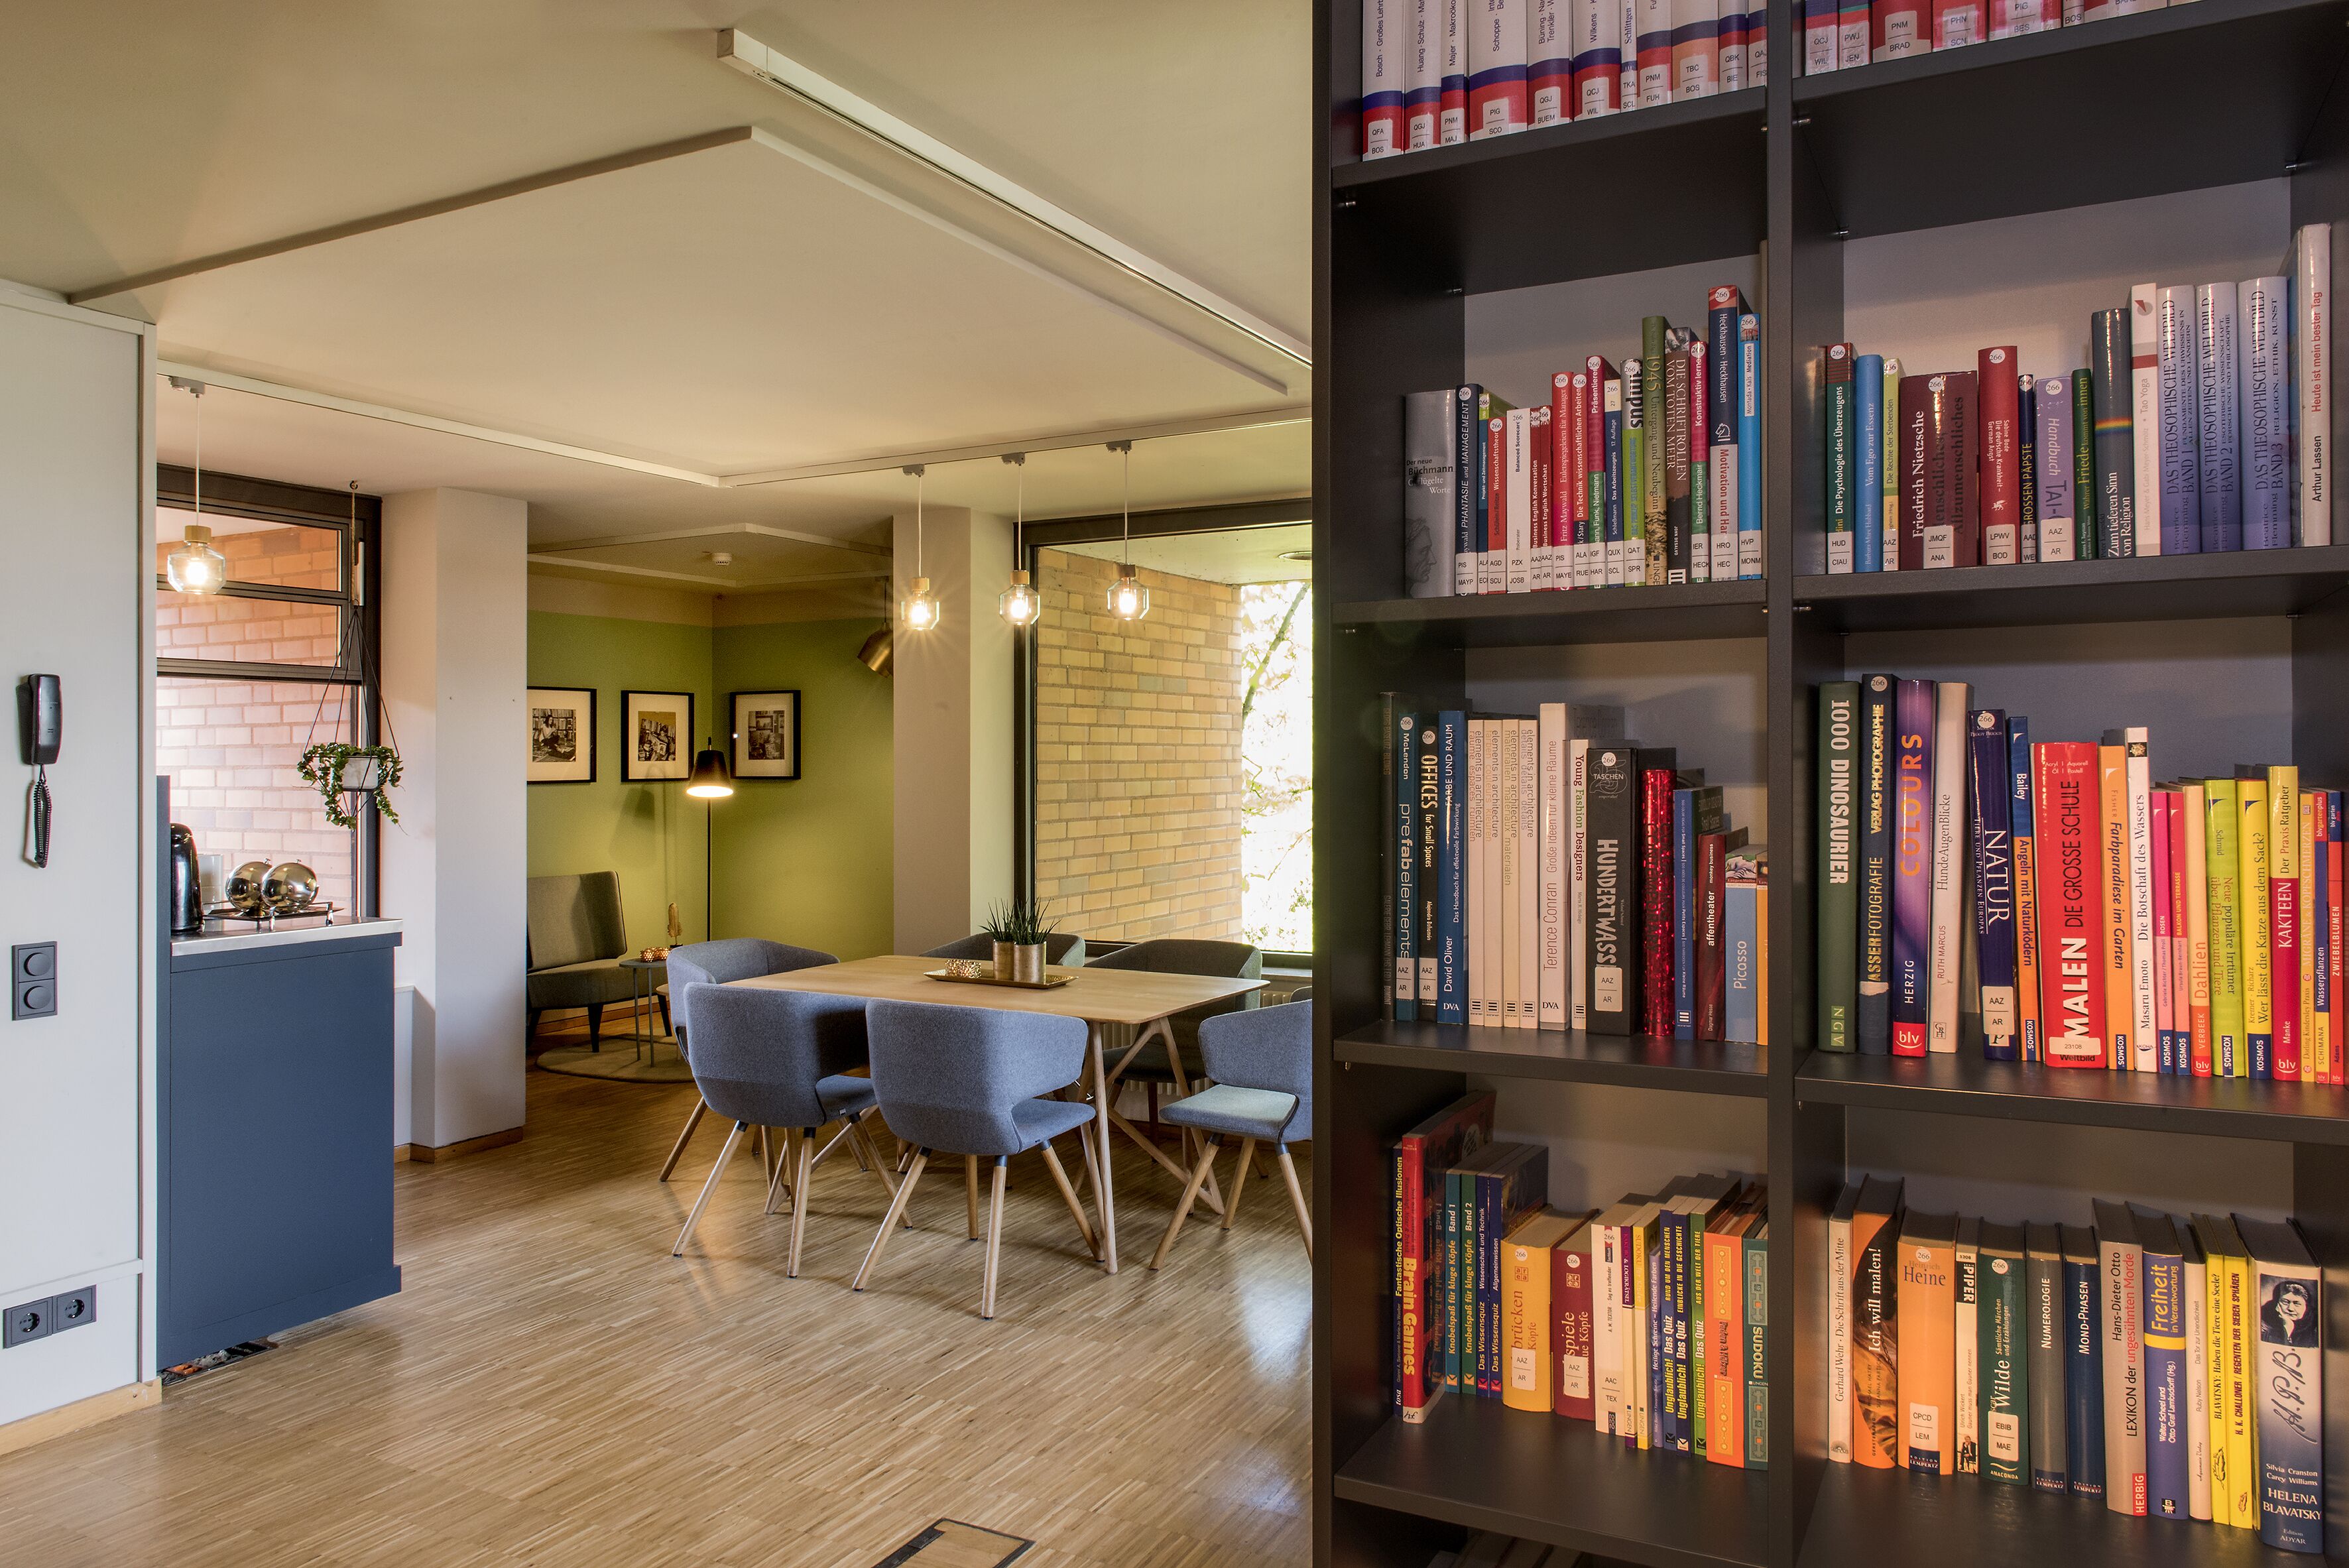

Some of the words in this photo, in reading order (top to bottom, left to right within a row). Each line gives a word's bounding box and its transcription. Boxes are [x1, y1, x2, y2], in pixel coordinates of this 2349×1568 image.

[1891, 21, 1908, 30] PNM
[1417, 48, 1426, 73] Huang
[1890, 40, 1910, 52] BRAD
[1539, 95, 1552, 104] QGJ
[1537, 114, 1555, 125] BUEM
[2311, 291, 2322, 308] Tag
[2311, 311, 2321, 341] bester
[1675, 359, 1686, 380] DIE
[2311, 343, 2321, 366] mein
[1666, 359, 1675, 387] VOM
[2312, 369, 2321, 381] ist
[1559, 389, 1567, 418] Manager
[1666, 390, 1675, 433] TOTEN
[1833, 387, 1844, 437] Überzeugens
[2253, 356, 2268, 462] THEOSOPHISCHE
[2312, 383, 2322, 412] Heute
[1461, 402, 1469, 464] MANAGEMENT
[1675, 383, 1687, 481] SCHRIFTROLLEN
[1865, 402, 1874, 431] Essenz
[1559, 430, 1569, 483] Eulenspiegeleien
[1666, 436, 1675, 470] MEER
[1834, 438, 1842, 452] des
[1866, 448, 1876, 465] Ego
[1911, 411, 1925, 475] Nietzsche
[2047, 418, 2061, 475] Handbuch
[2312, 436, 2322, 470] Lassen
[1834, 454, 1845, 499] Psychologie
[1866, 467, 1874, 487] Vom
[2077, 447, 2090, 483] Friede
[2255, 464, 2268, 490] DAS
[2271, 455, 2284, 489] BAND
[1695, 464, 1704, 500] Heckmair
[2106, 472, 2117, 494] Sinn
[2312, 471, 2322, 503] Arthur
[1559, 491, 1569, 523] Maywald
[1695, 501, 1704, 524] Bernd
[1911, 478, 1925, 538] Friedrich
[2107, 495, 2118, 531] tieferen
[2120, 497, 2132, 536] Religion
[1990, 532, 2010, 540] LPWV
[2108, 532, 2119, 557] Zum
[1831, 699, 1849, 751] 1000
[1420, 756, 1437, 809] OFFICES
[1574, 756, 1585, 787] Young
[1573, 790, 1583, 828] Fashion
[1830, 760, 1848, 884] DINOSAURIER
[1900, 735, 1922, 876] COLOURS
[2060, 781, 2080, 837] SCHULE
[2134, 793, 2145, 838] Wassers
[1573, 832, 1585, 882] Designers
[1937, 795, 1952, 891] HundeAugenBlicke
[2136, 842, 2145, 861] des
[2253, 833, 2266, 864] Sack?
[1984, 831, 2010, 926] NATUR
[2062, 841, 2082, 902] GROSSE
[2108, 823, 2124, 902] Farbparadiese
[2136, 864, 2147, 918] Botschaft
[2255, 868, 2265, 893] dem
[1543, 883, 1557, 924] Conran
[1706, 890, 1715, 947] affentheater
[2064, 906, 2084, 928] DIE
[2111, 908, 2123, 923] im
[2258, 896, 2266, 915] aus
[2277, 882, 2293, 949] KAKTEEN
[2137, 921, 2148, 941] Die
[2256, 918, 2267, 950] Katze
[2331, 907, 2340, 977] ZWIEBELBLUMEN
[1443, 936, 1453, 965] Oliver
[1543, 927, 1558, 972] Terence
[2112, 928, 2125, 969] Garten
[2258, 953, 2267, 970] die
[1443, 967, 1453, 993] David
[1733, 941, 1748, 990] Picasso
[1904, 960, 1915, 1004] HERZIG
[2193, 941, 2208, 999] Dahlien
[2316, 947, 2326, 1006] Wasserpflanzen
[2061, 937, 2090, 1040] MALEN
[2258, 972, 2268, 998] lässt
[2258, 1000, 2269, 1024] Wer
[2198, 1013, 2206, 1049] VERBEEK
[1448, 1211, 1457, 1233] Band
[1447, 1240, 1458, 1265] Köpfe
[2110, 1252, 2122, 1277] Otto
[1403, 1258, 1417, 1310] Brain
[1447, 1266, 1458, 1290] kluge
[1867, 1247, 1880, 1294] malen!
[1903, 1266, 1947, 1286] Heine
[2123, 1254, 2136, 1290] Morde
[2210, 1274, 2220, 1297] Seele?
[1447, 1292, 1456, 1303] für
[1868, 1299, 1880, 1325] will
[2110, 1279, 2123, 1341] Hans-Dieter
[2151, 1264, 2168, 1331] Freiheit
[1447, 1305, 1457, 1355] Knobelspaß
[1675, 1321, 1686, 1339] Quiz
[1868, 1330, 1880, 1352] Ich
[2123, 1292, 2140, 1364] ungesühnten
[2211, 1317, 2220, 1335] Tiere
[1403, 1313, 1415, 1375] Games
[1677, 1341, 1686, 1359] Das
[1752, 1326, 1764, 1379] SUDOKU
[2211, 1337, 2220, 1349] die
[2125, 1366, 2138, 1384] der
[2212, 1349, 2221, 1374] Haben
[1677, 1364, 1688, 1419] Unglaublich!
[1994, 1360, 2011, 1408] Wilde
[2212, 1375, 2222, 1419] BLAVATSKY:
[2125, 1387, 2138, 1437] LEXIKON
[2261, 1501, 2322, 1520] BLAVATSKY
[2267, 1487, 2318, 1505] HELENA
